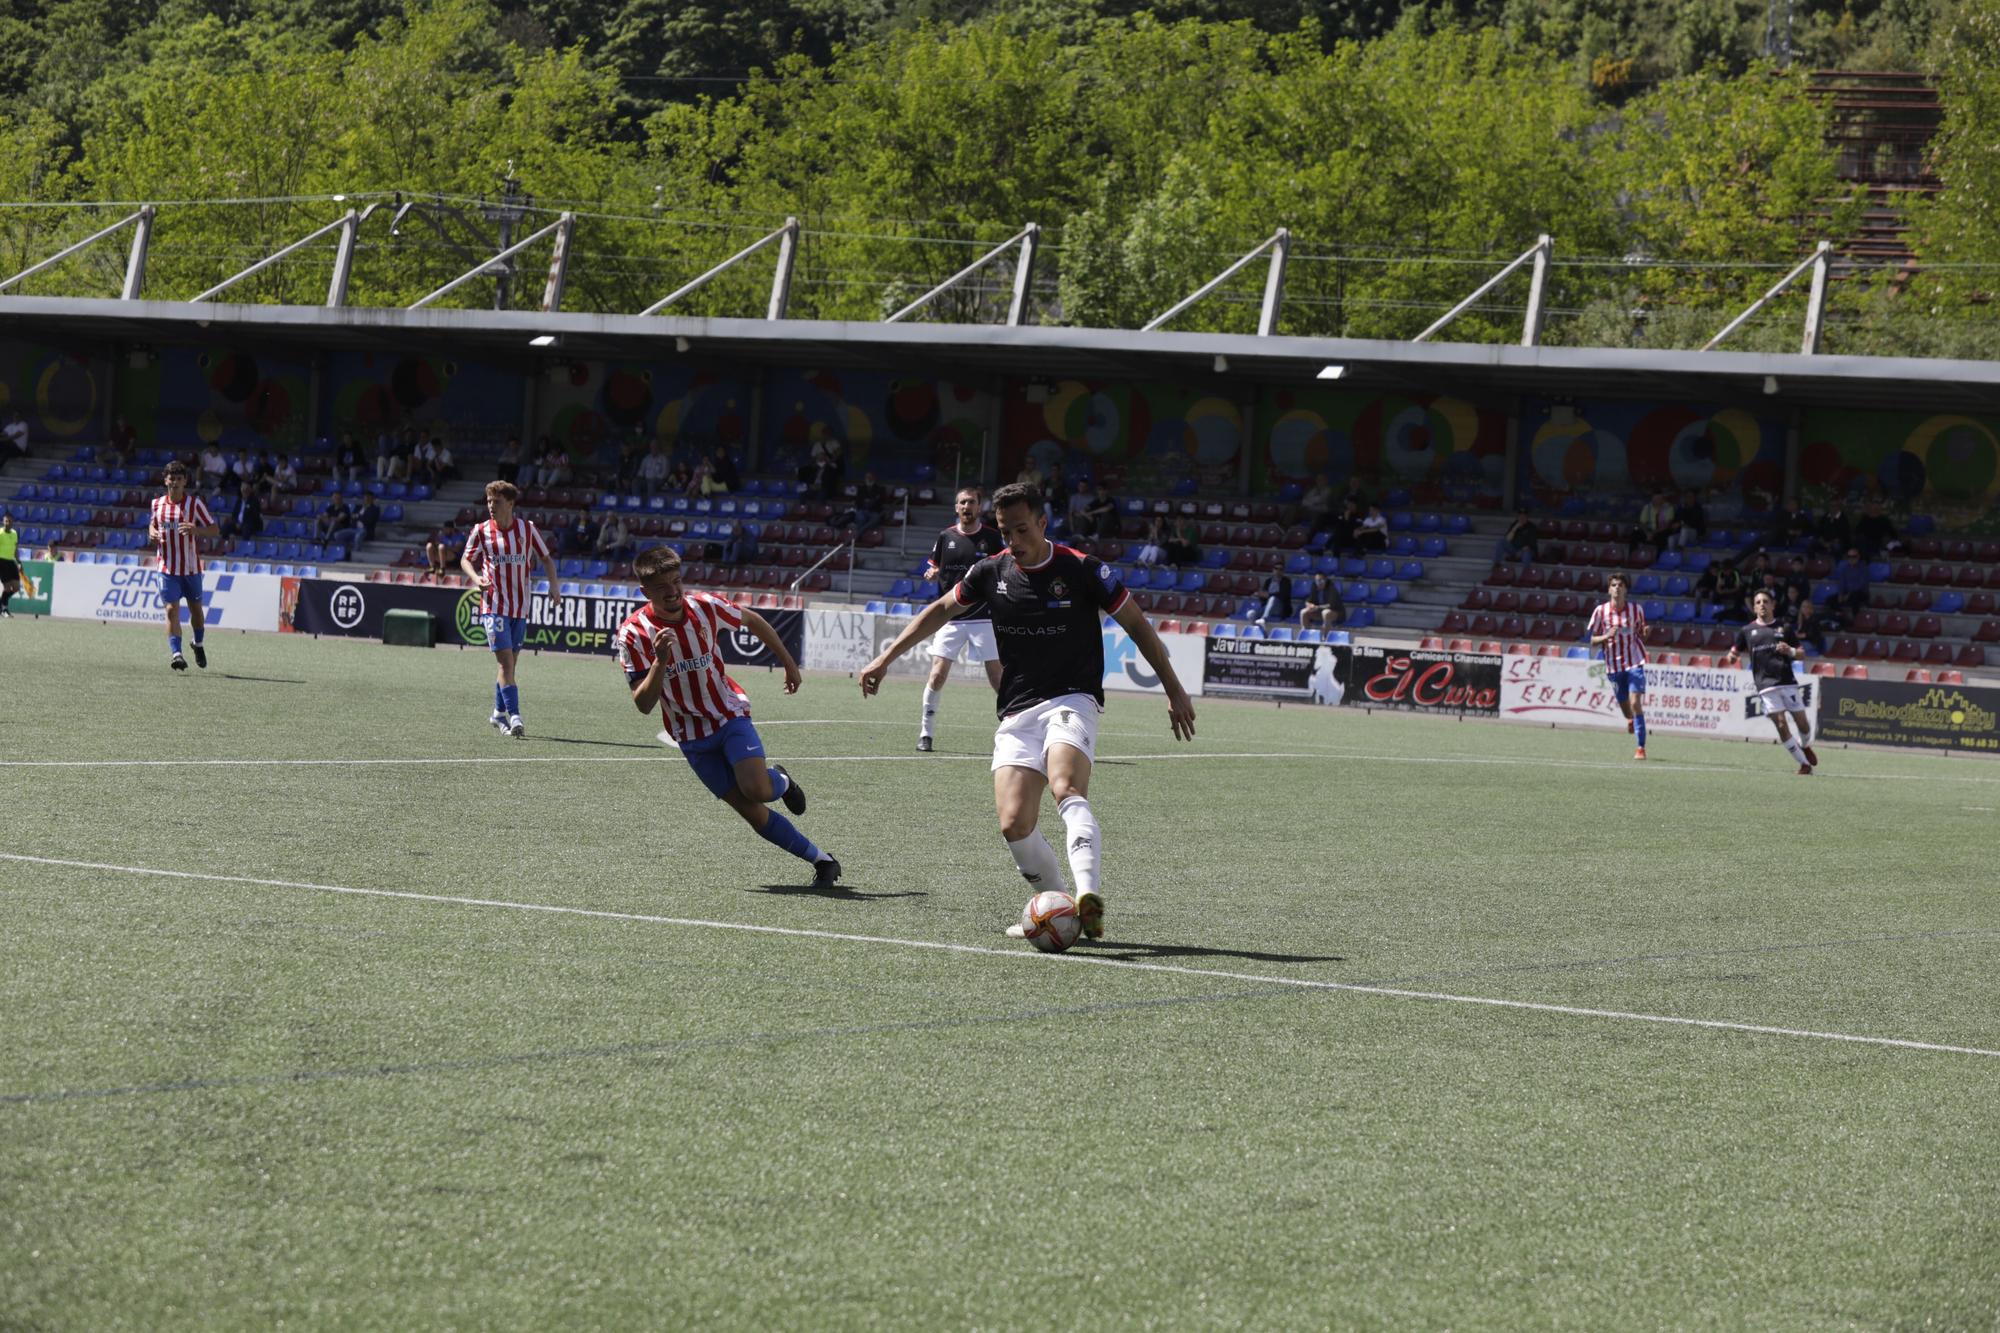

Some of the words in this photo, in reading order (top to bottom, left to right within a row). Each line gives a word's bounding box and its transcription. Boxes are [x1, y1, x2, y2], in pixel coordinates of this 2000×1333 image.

[111, 568, 160, 588] CAR
[96, 608, 166, 621] carsauto.es
[527, 595, 587, 628] RCERA
[523, 629, 561, 645] LAY
[566, 631, 608, 648] OFF
[1213, 638, 1251, 653] Javier
[677, 653, 712, 673] INTEGR
[1364, 656, 1415, 701] El
[1413, 662, 1497, 708] Cura
[1642, 694, 1658, 706] LF:
[1661, 694, 1681, 708] 985
[1684, 696, 1697, 709] 69
[1701, 697, 1714, 710] 23
[1717, 698, 1730, 712] 26
